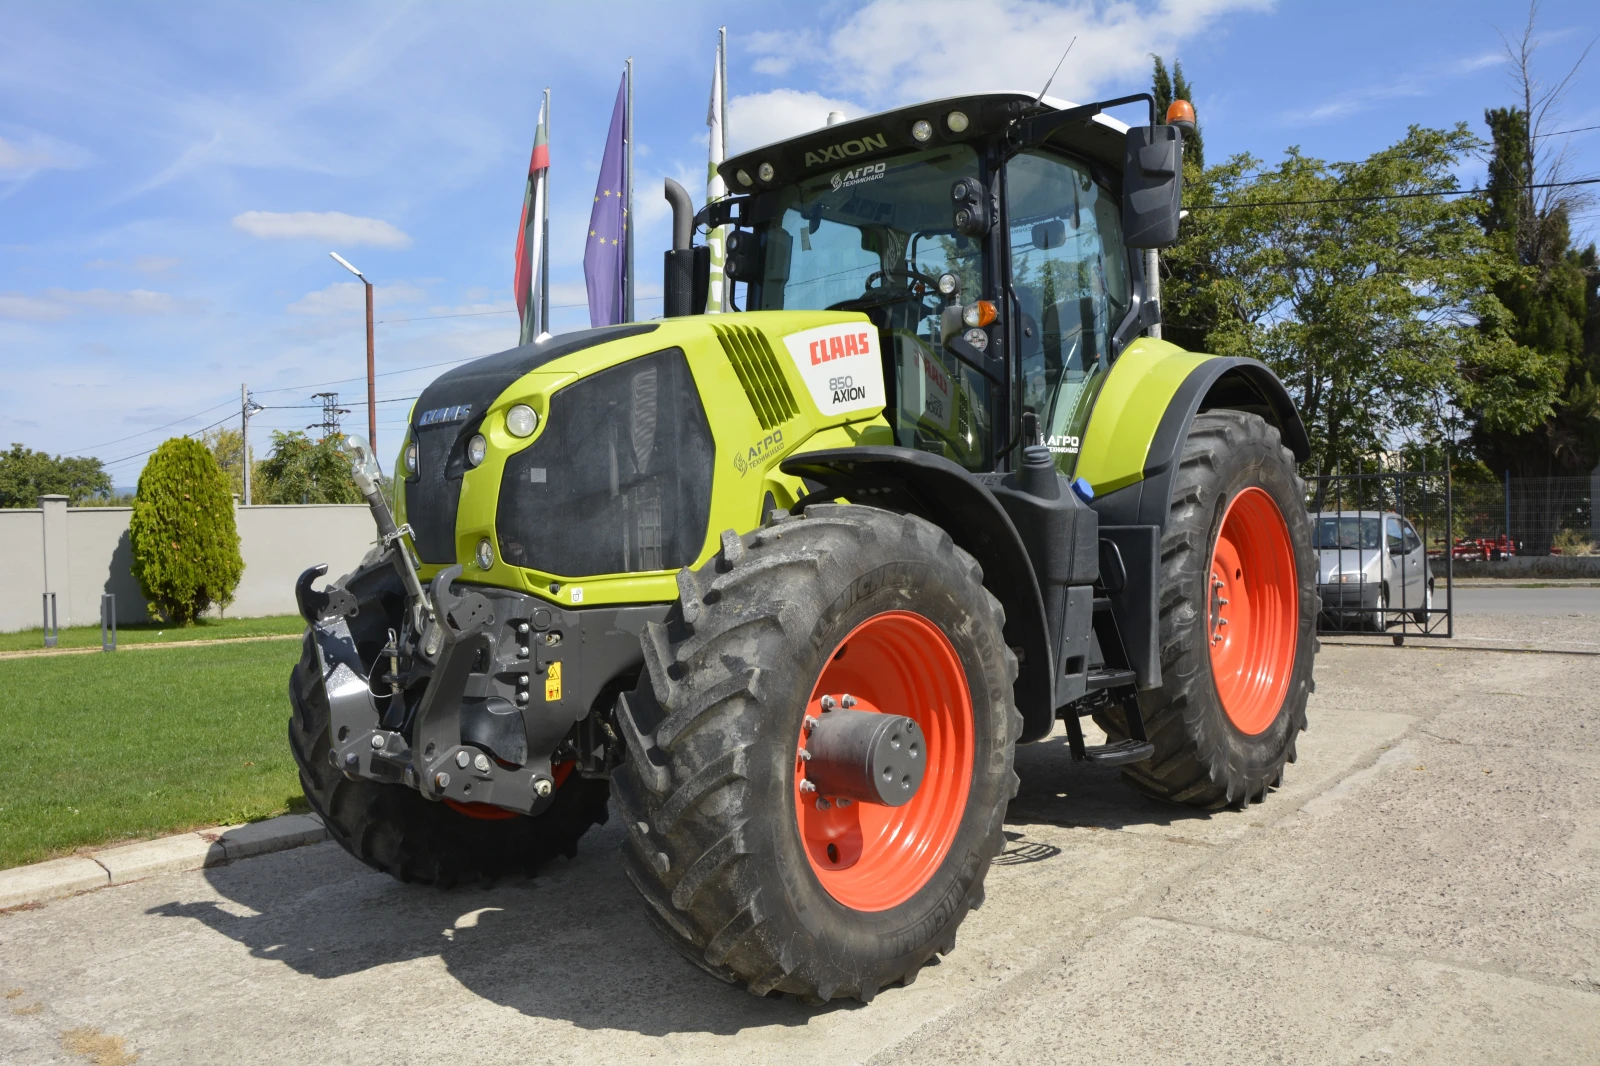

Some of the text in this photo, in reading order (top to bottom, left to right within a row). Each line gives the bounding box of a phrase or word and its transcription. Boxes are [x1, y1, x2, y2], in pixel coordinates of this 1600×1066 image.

[804, 132, 888, 168] AXION
[843, 162, 886, 181] АГРО
[809, 332, 870, 366] CLAAS
[829, 375, 853, 391] 850
[832, 385, 865, 404] AXION
[748, 429, 783, 461] АГРО
[1047, 434, 1079, 447] АГРО
